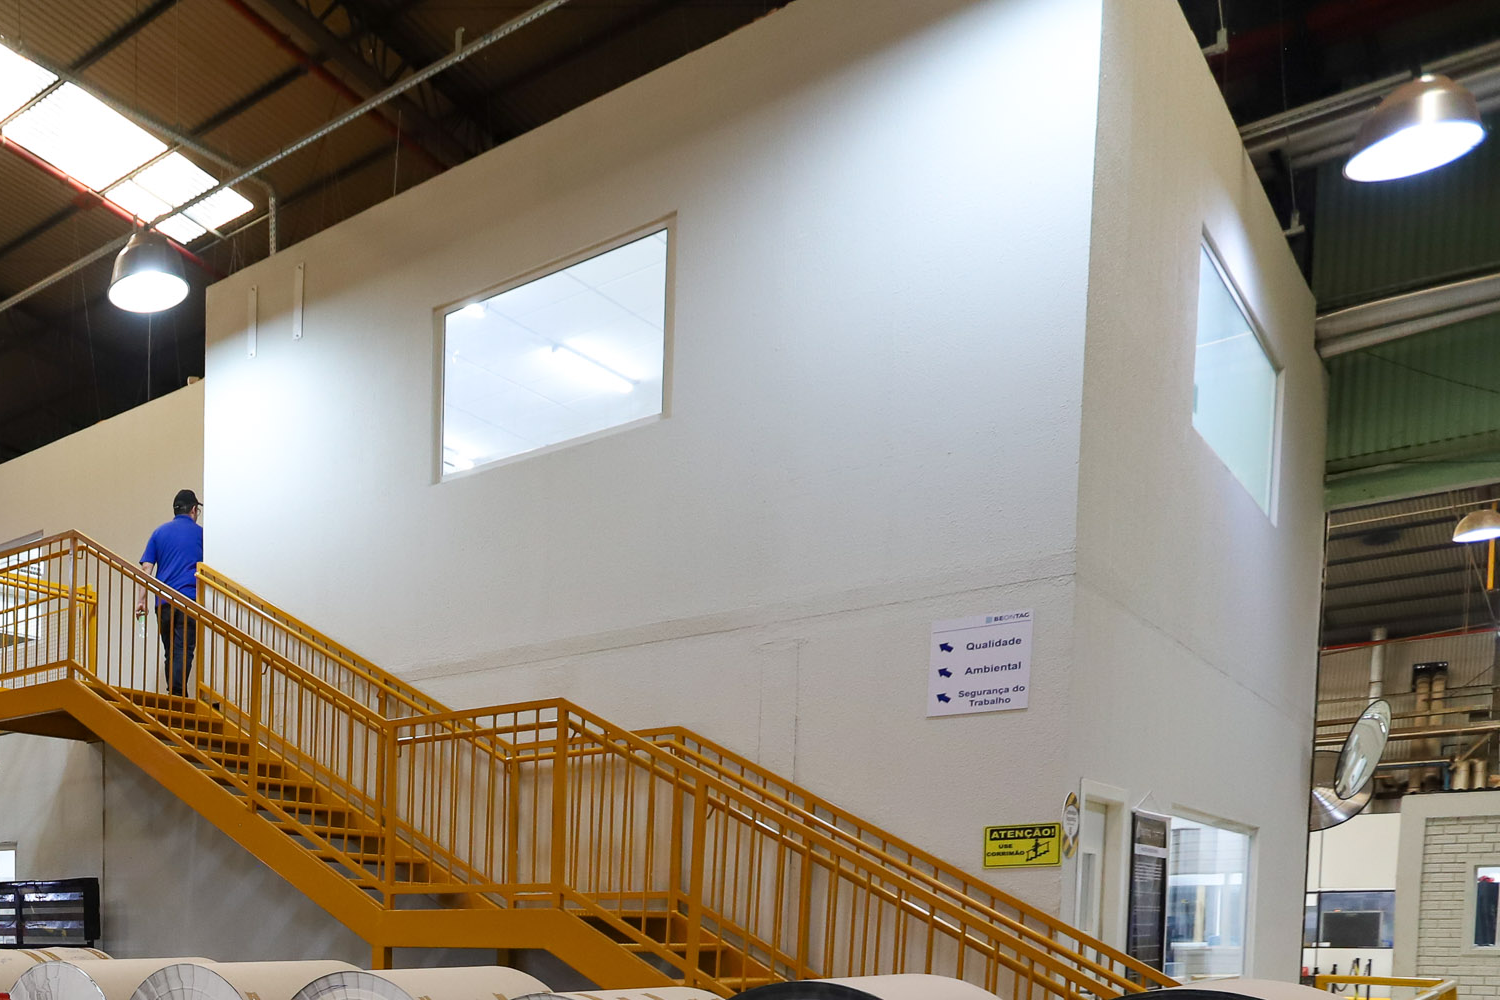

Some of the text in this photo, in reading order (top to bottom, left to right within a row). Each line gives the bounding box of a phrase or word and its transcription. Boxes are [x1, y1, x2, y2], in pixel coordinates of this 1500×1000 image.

[966, 637, 1022, 650] Qualidade
[964, 661, 1021, 675] Ambiental
[958, 686, 1009, 698] Segurança
[969, 697, 1011, 707] Trabalho
[990, 827, 1055, 839] ATENÇÃO!
